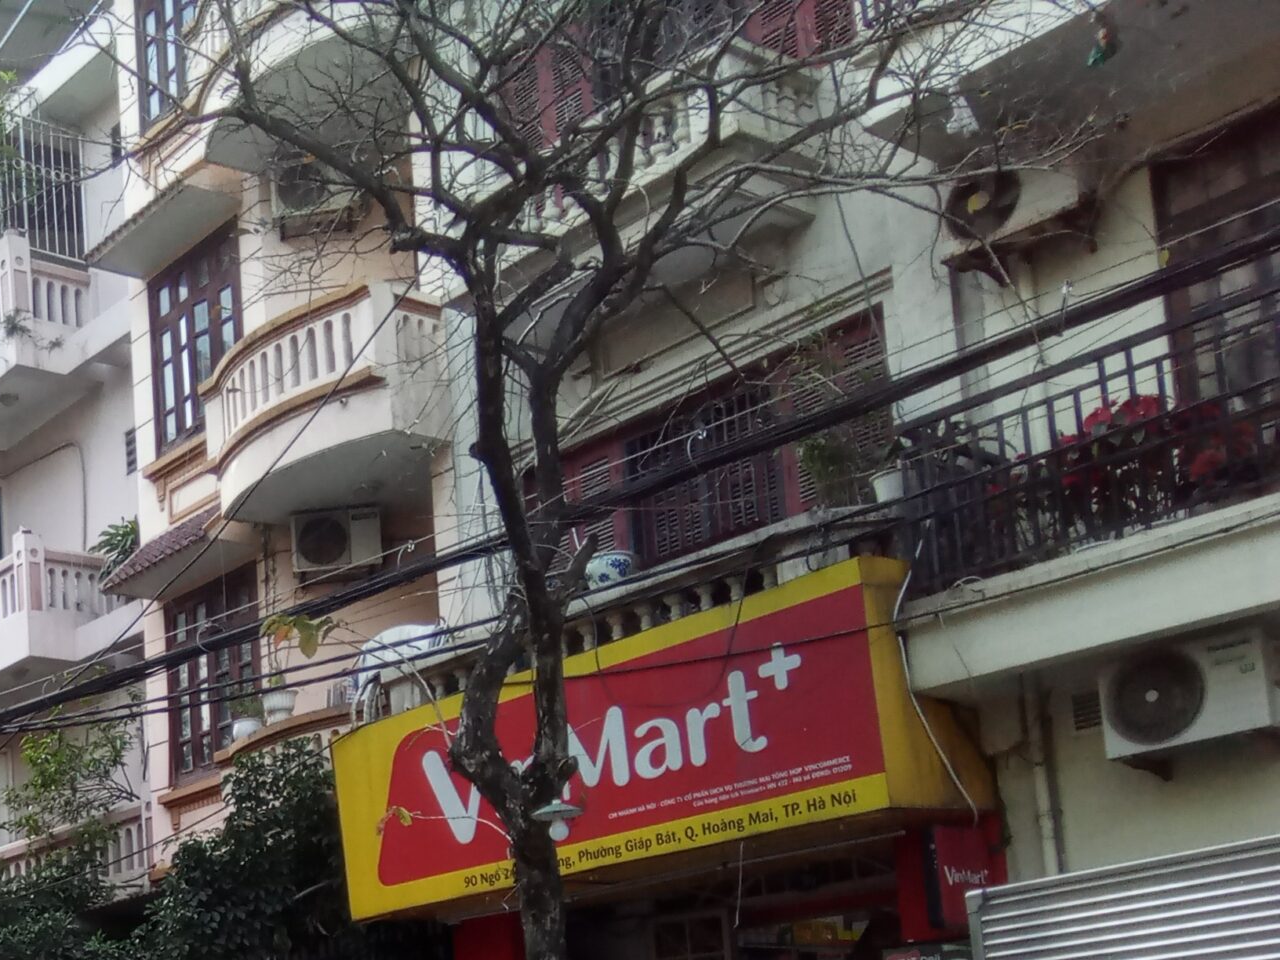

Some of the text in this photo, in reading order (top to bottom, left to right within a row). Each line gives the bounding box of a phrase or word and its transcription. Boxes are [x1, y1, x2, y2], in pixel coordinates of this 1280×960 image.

[422, 641, 801, 845] VMart+
[578, 845, 623, 863] Phường
[625, 837, 652, 852] Giáp
[656, 831, 681, 846] Bát,
[684, 826, 699, 842] Q.
[702, 817, 745, 836] Hoàng
[748, 808, 779, 826] Mai,
[782, 802, 802, 818] TP.
[806, 797, 827, 813] Hà
[831, 789, 857, 809] Nội
[463, 875, 478, 888] 90
